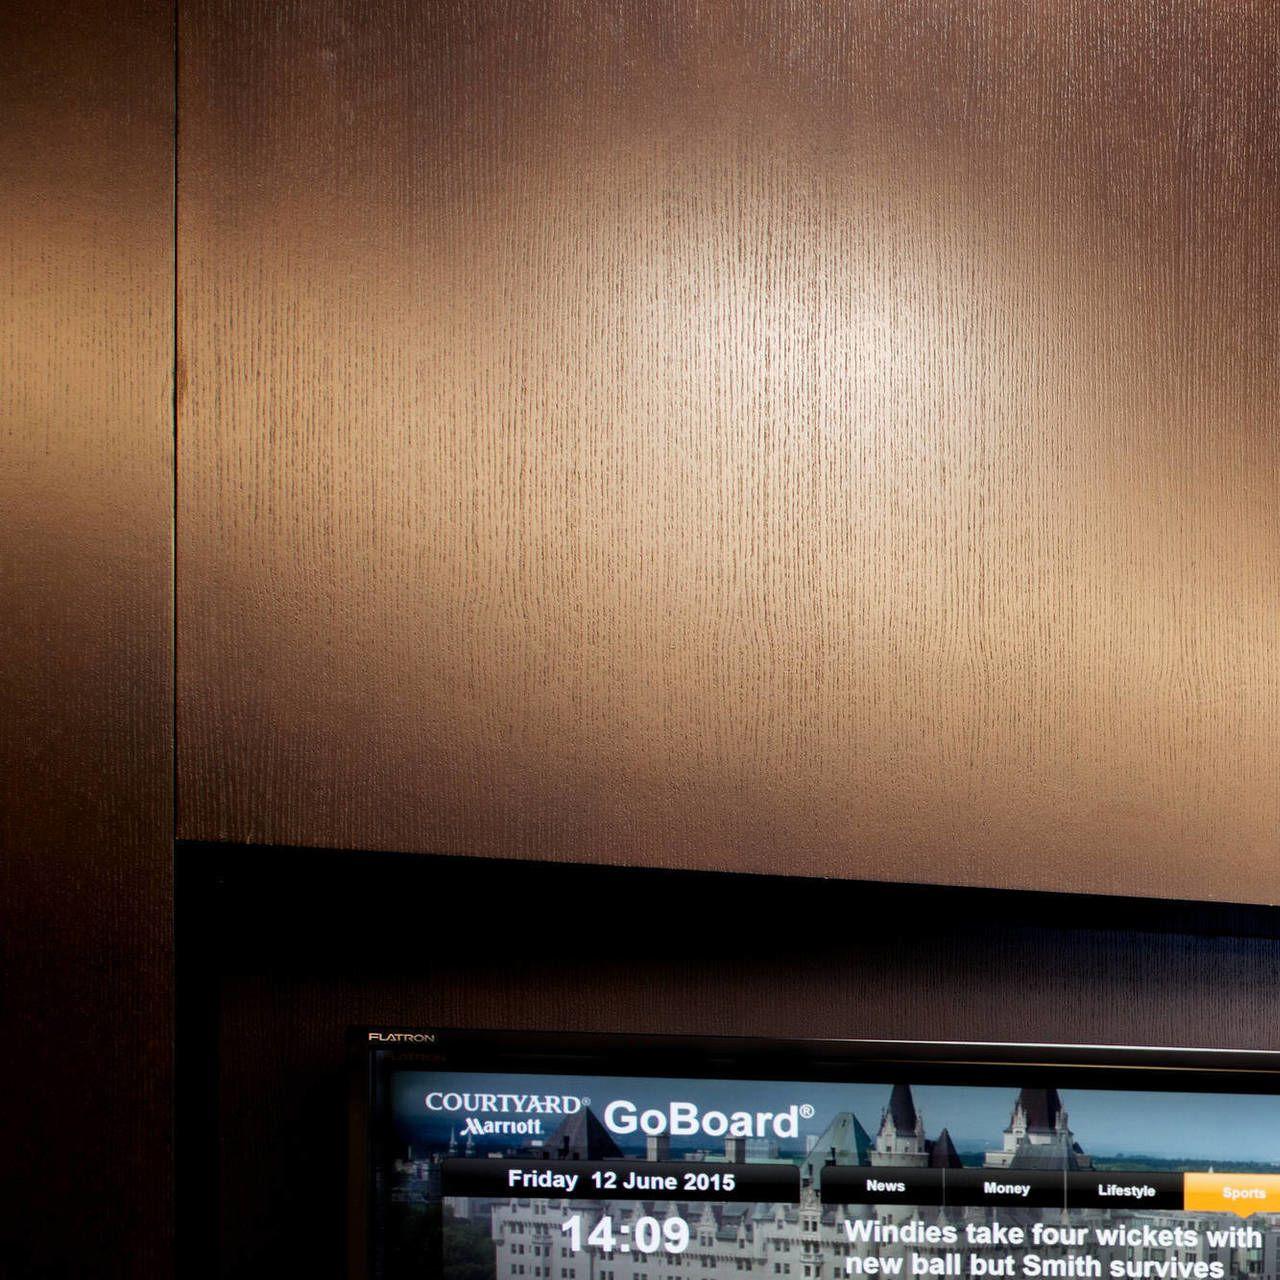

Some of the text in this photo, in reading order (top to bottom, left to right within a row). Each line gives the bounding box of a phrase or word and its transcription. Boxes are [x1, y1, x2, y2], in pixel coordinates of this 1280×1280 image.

[368, 1032, 436, 1042] FLATRON
[508, 1169, 735, 1192] Friday 12 June 2015
[866, 1179, 906, 1192] News
[984, 1181, 1031, 1197] Money
[1098, 1184, 1156, 1199] Lifestyle
[1222, 1186, 1266, 1200] Sports
[561, 1215, 690, 1254] 14:09
[844, 1219, 1263, 1249] Windies take four wickets with
[845, 1253, 1225, 1279] new ball but Smith survives
